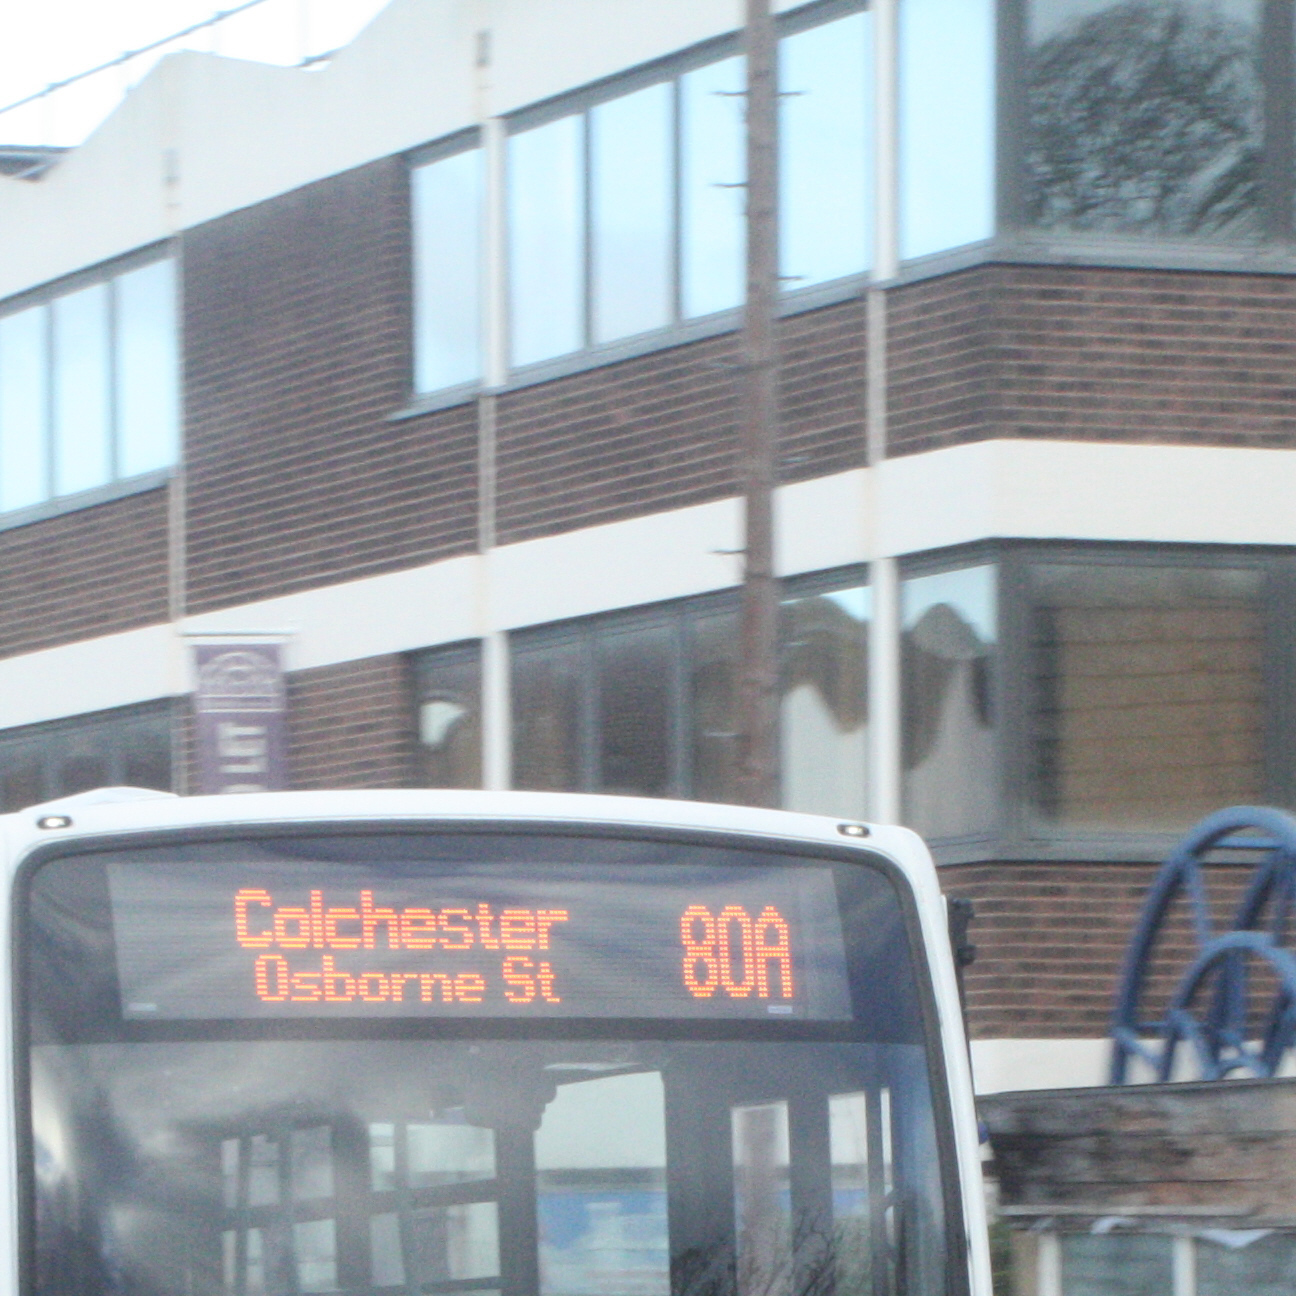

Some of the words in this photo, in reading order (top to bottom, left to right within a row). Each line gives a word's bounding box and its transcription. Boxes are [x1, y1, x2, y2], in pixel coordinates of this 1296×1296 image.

[235, 889, 570, 951] Colchester
[256, 955, 485, 1004] Osborne
[504, 956, 561, 1004] St
[681, 905, 793, 999] 80A
